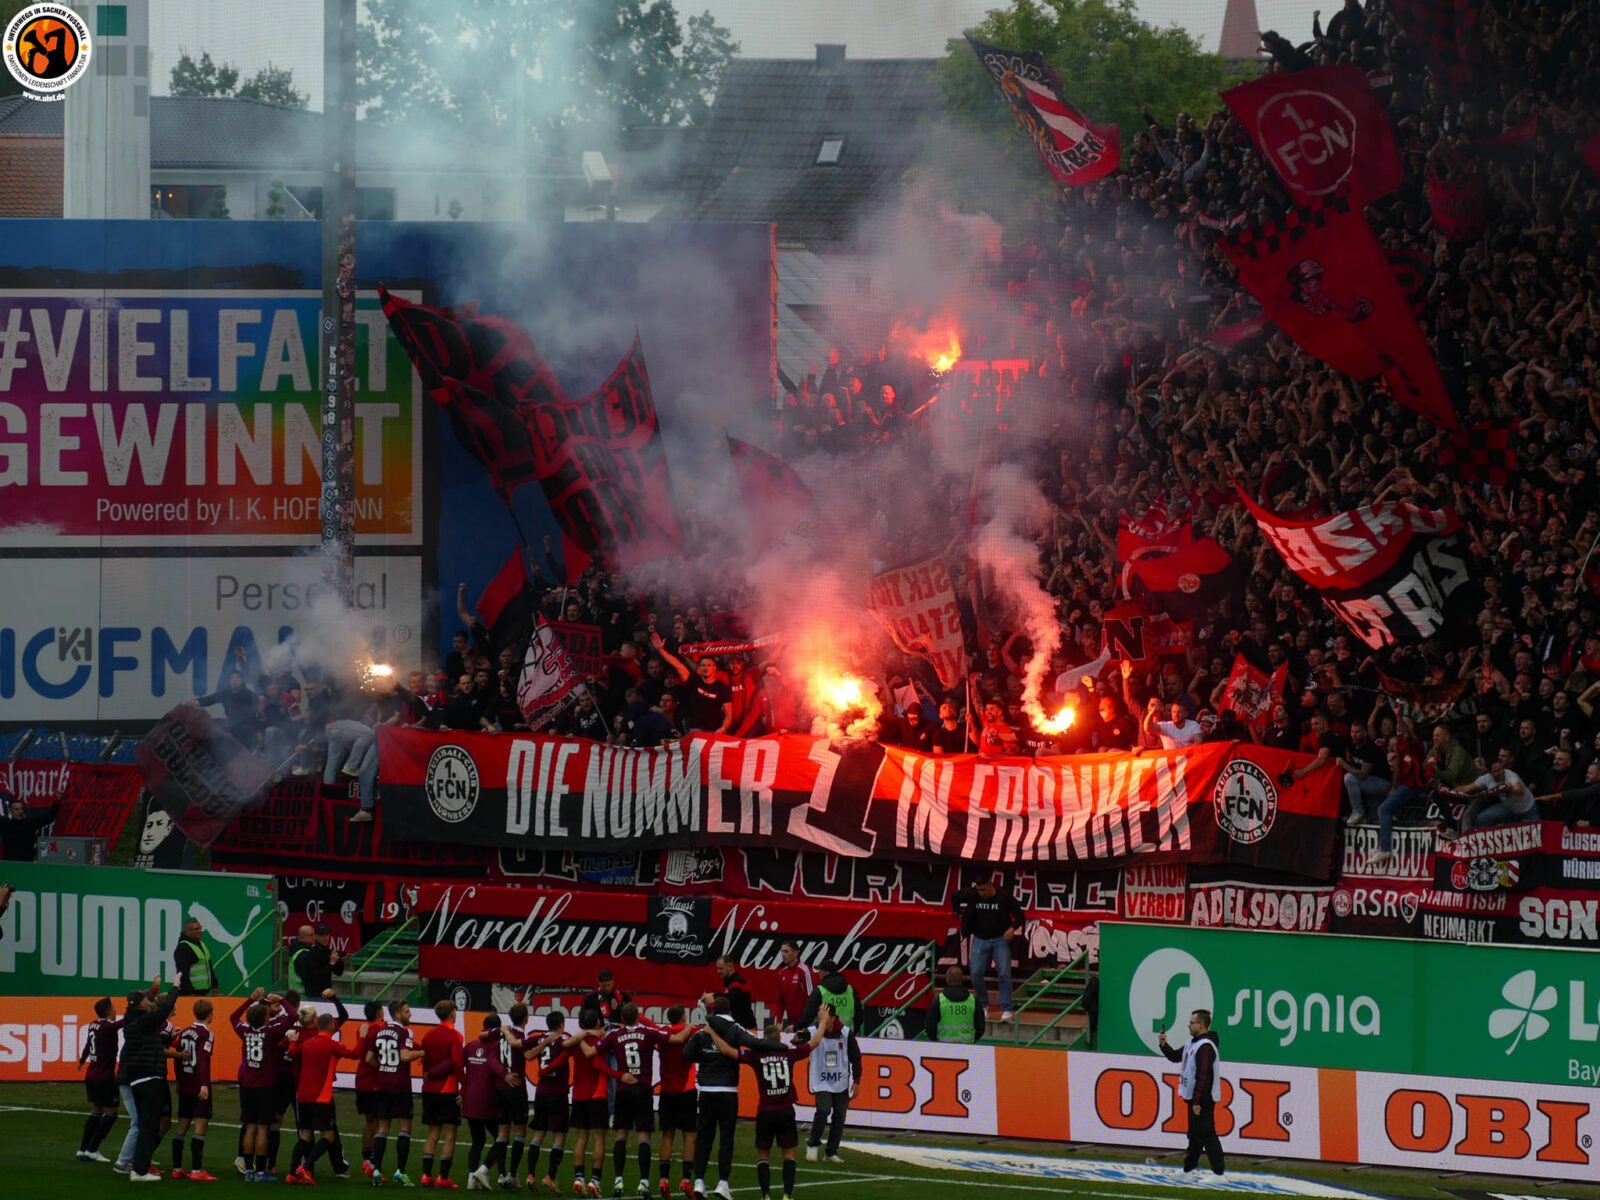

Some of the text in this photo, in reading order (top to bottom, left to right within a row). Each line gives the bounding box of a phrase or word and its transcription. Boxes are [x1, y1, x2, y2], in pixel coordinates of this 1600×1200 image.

[1275, 119, 1350, 177] FCN
[96, 498, 189, 521] Powered
[196, 498, 222, 526] by
[247, 498, 267, 520] K.
[216, 573, 387, 611] Persal
[444, 759, 457, 779] 1.
[436, 779, 467, 800] FCN
[505, 737, 1191, 862] DIE NUMMER 1 IN FRANKEN
[1236, 774, 1251, 797] 1.
[1225, 796, 1264, 822] FCN
[306, 900, 325, 923] OF
[1126, 891, 1185, 918] VERBOT
[1191, 887, 1331, 931] ADELSDORF
[1352, 888, 1398, 918] RSR
[418, 886, 648, 960] Nordkurve
[1423, 913, 1496, 943] NEUMARKT
[1519, 895, 1599, 941] SGN
[0, 889, 182, 984] PUMA
[950, 1004, 967, 1016] 188
[1228, 988, 1381, 1047] signia
[245, 1036, 264, 1062] 18
[375, 1038, 400, 1067] 36
[624, 1041, 642, 1069] 6
[762, 1060, 791, 1089] 44
[1384, 1088, 1590, 1165] OBI
